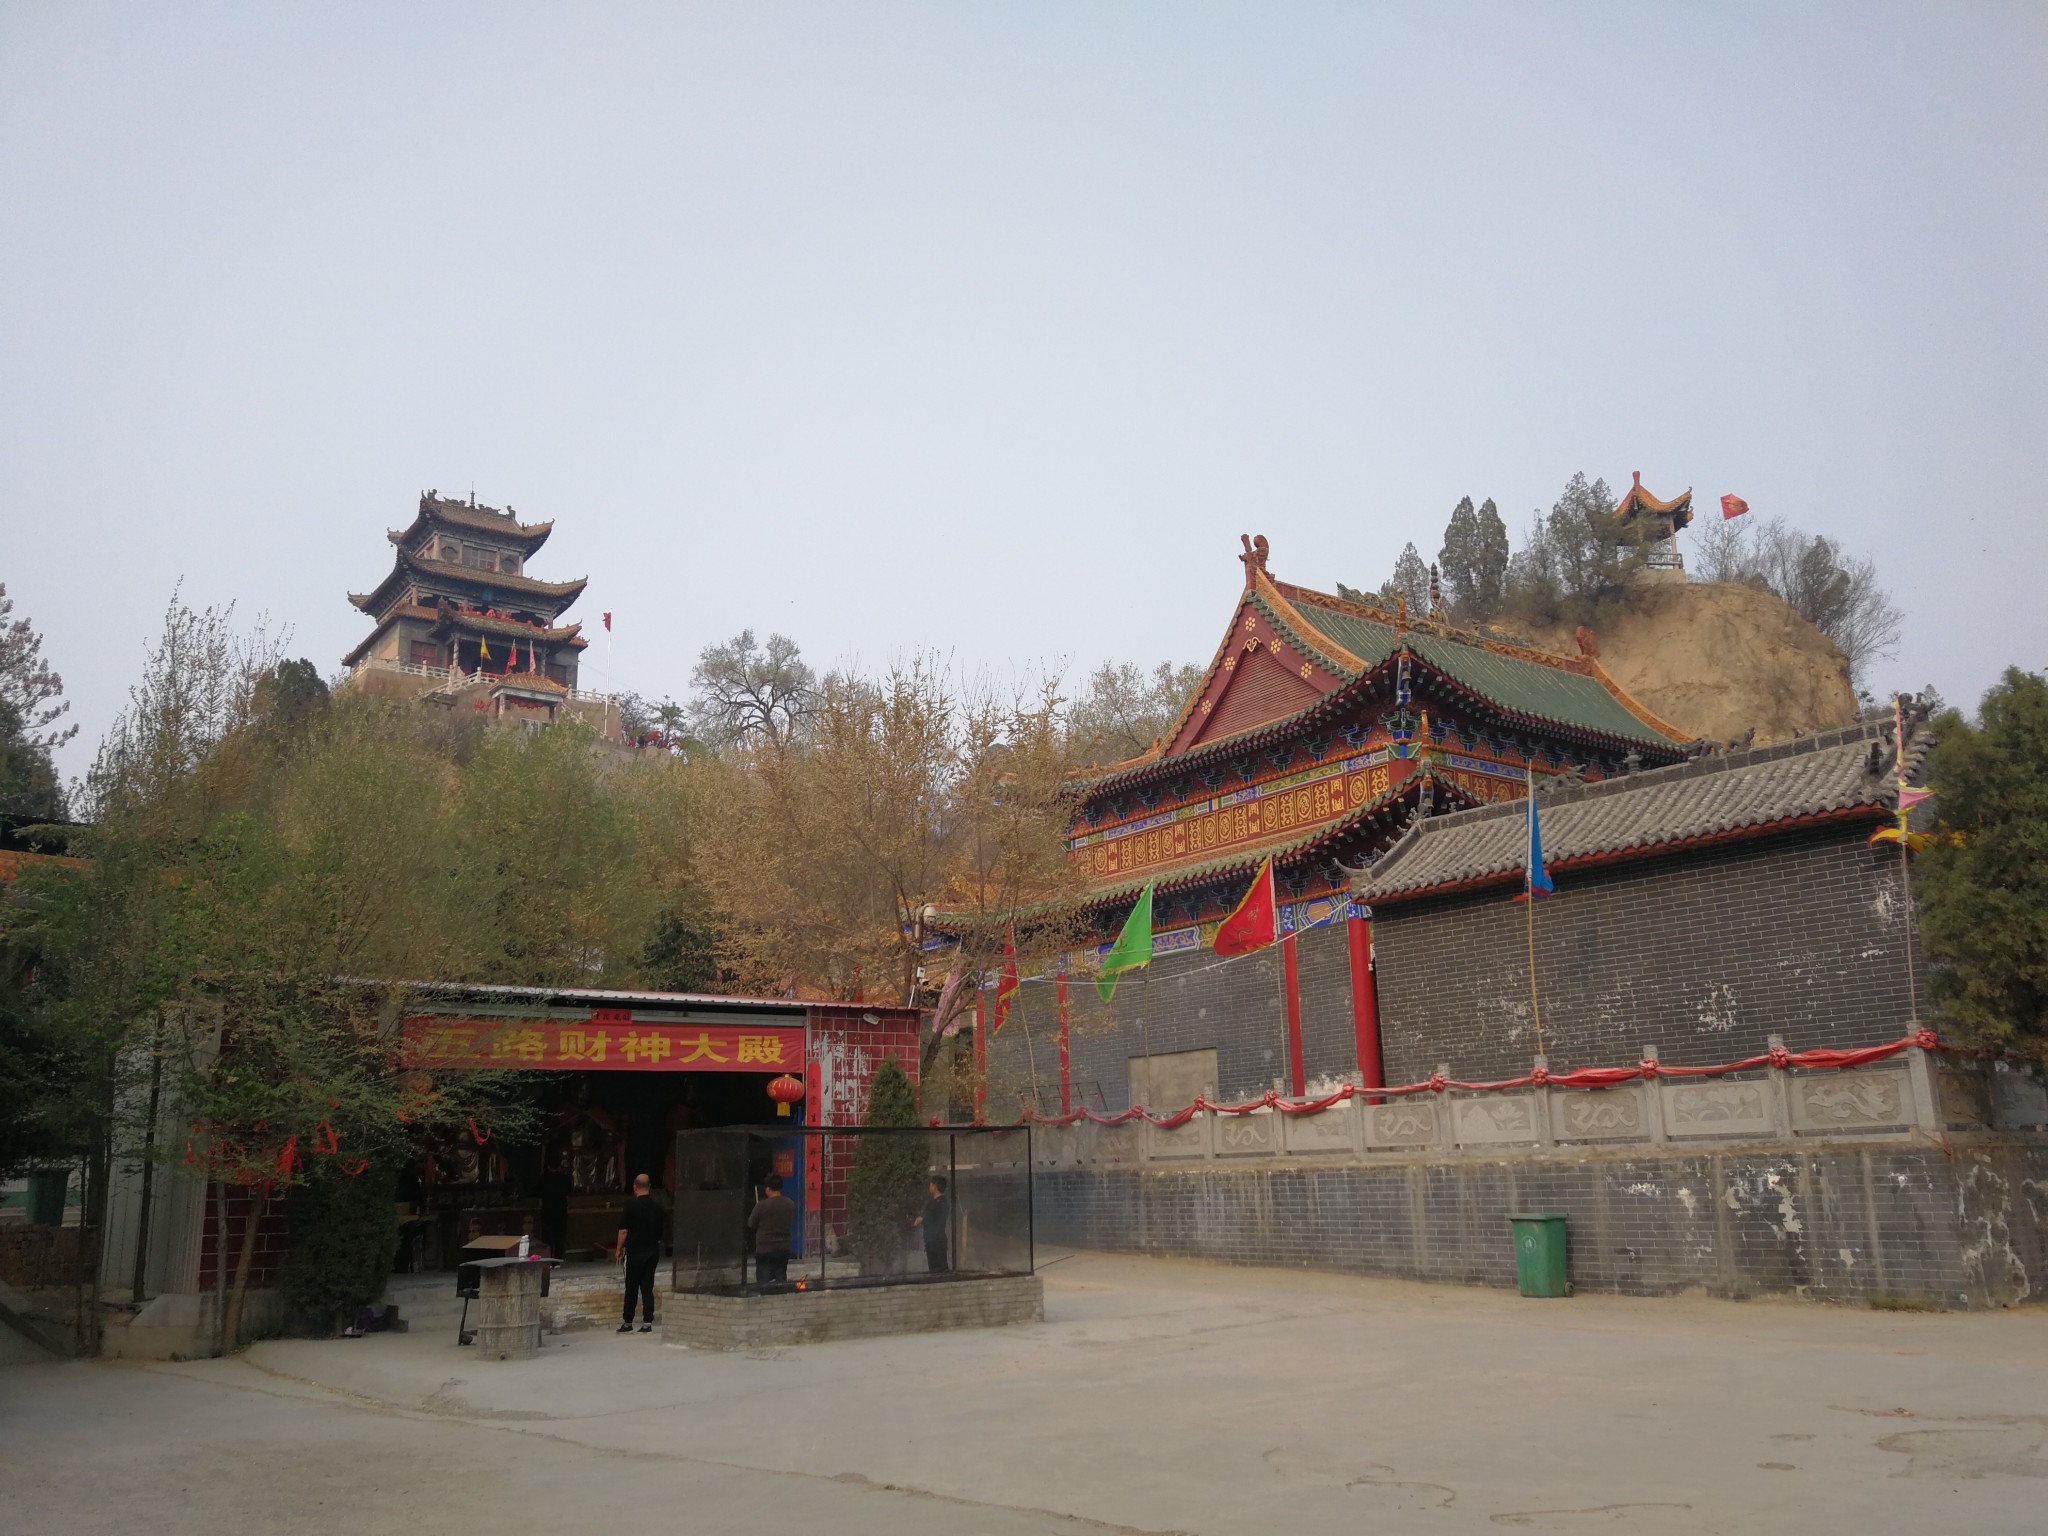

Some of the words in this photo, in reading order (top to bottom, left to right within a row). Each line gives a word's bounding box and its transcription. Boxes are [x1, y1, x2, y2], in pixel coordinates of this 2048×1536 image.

[427, 1028, 785, 1064] 五路财神大殿
